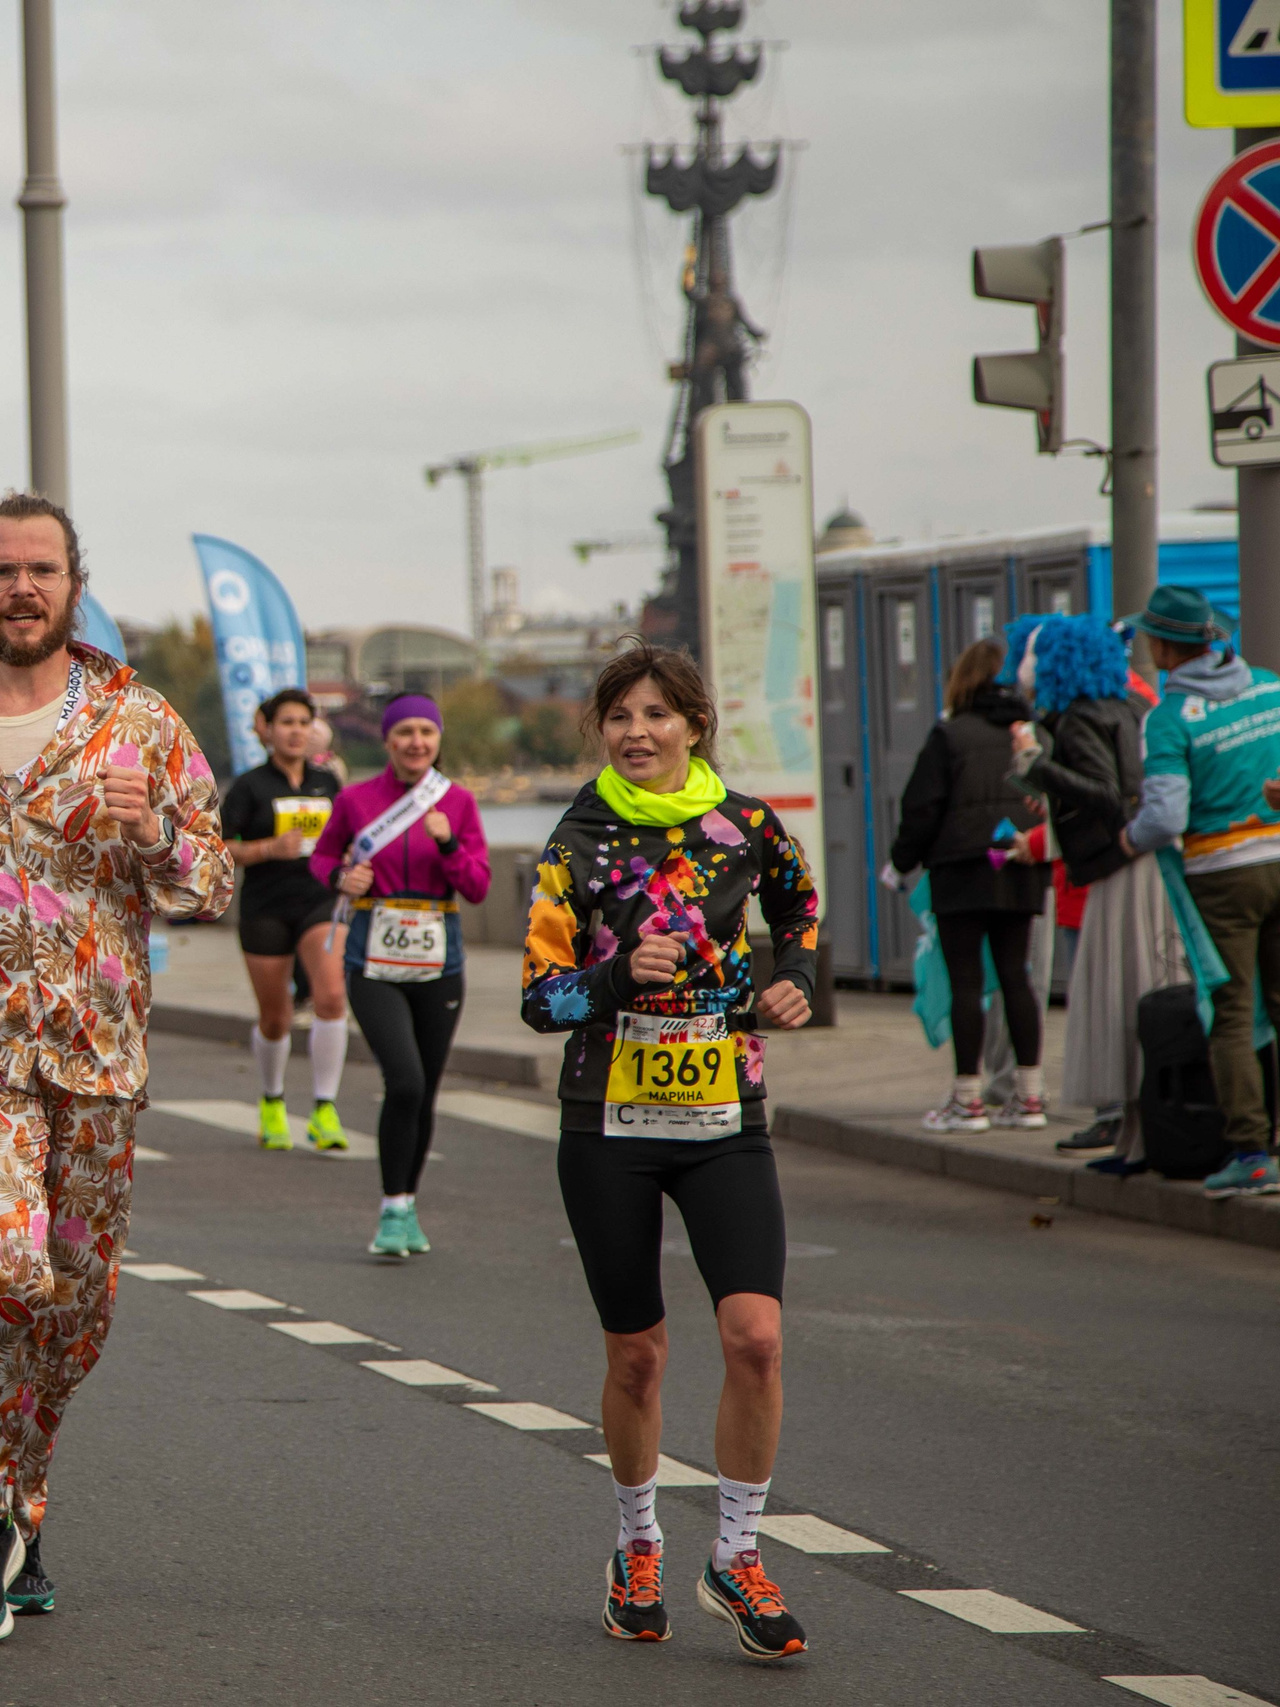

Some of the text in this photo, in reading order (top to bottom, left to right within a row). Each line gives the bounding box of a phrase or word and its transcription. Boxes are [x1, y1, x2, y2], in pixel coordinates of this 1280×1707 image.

[61, 662, 83, 720] МАРАФОН
[382, 928, 435, 950] 66-5
[693, 1017, 715, 1029] 42,2
[631, 1047, 722, 1087] 1369
[648, 1090, 705, 1102] МАРИНА
